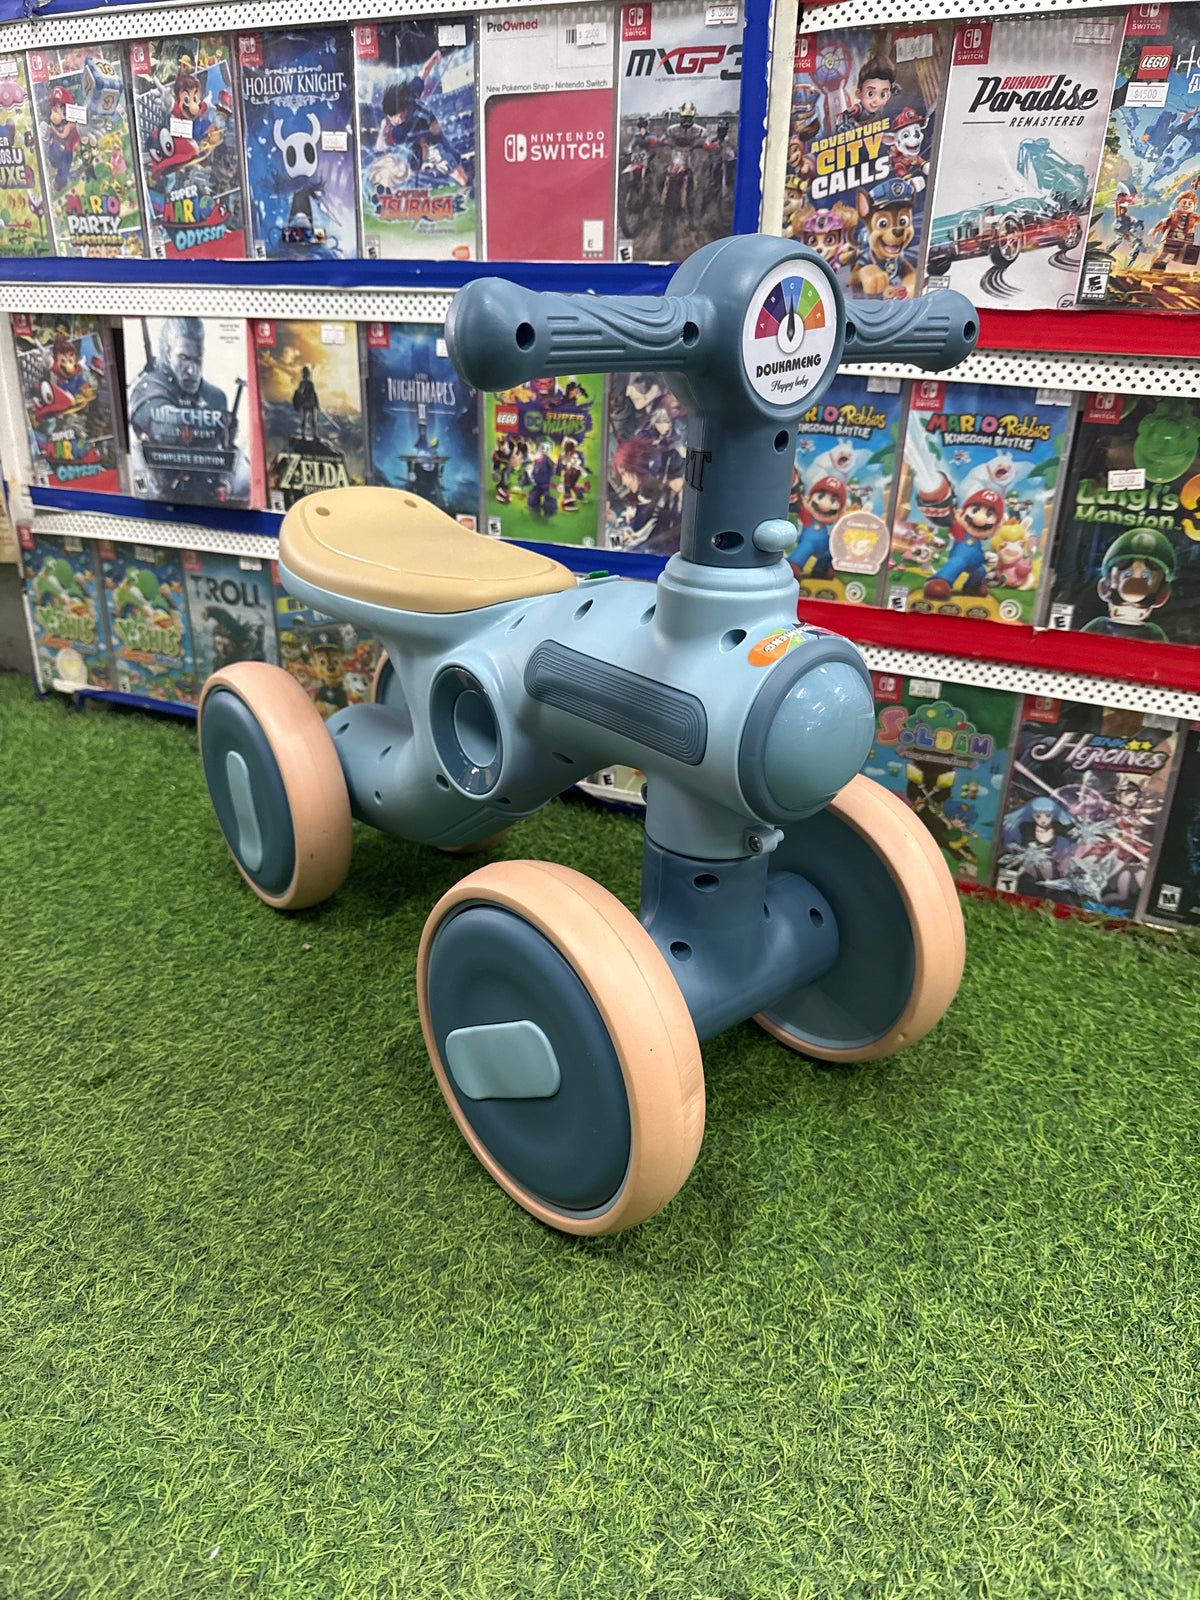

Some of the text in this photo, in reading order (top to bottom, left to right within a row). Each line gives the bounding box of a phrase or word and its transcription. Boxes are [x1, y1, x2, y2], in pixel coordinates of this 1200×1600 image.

[487, 19, 538, 32] PreOwned
[1141, 56, 1169, 68] LEGO
[245, 72, 345, 96] HOLLOW KNIGHT
[486, 84, 500, 92] New
[532, 80, 549, 92] Snap
[554, 79, 584, 89] Nintendo
[586, 79, 608, 88] Switch
[1001, 75, 1054, 90] BURNOUT
[968, 74, 1099, 113] Paradise
[1009, 115, 1085, 128] REMASTERED
[530, 130, 605, 143] NINTENDO
[811, 117, 890, 154] ADVENTURE
[530, 142, 604, 161] SWITCH
[816, 132, 883, 176] CITY
[811, 155, 890, 200] CALLS
[170, 184, 198, 202] SUPER
[66, 194, 120, 215] MARIO
[378, 194, 455, 220] TSUBASA
[68, 214, 121, 234] PARTY
[756, 354, 822, 378] DOUKAMENG
[387, 376, 456, 406] NIGHTMARES
[150, 404, 225, 429] WITCHER
[497, 412, 518, 425] LEGO
[926, 413, 999, 433] MARIO
[835, 424, 872, 439] BATTLE
[943, 432, 1034, 450] KINGDOM BATTLE
[192, 455, 226, 466] EDITION
[277, 452, 350, 489] ZELDA
[1076, 478, 1180, 512] Luigi's
[1074, 505, 1176, 530] Mansion
[189, 574, 262, 608] TROLL
